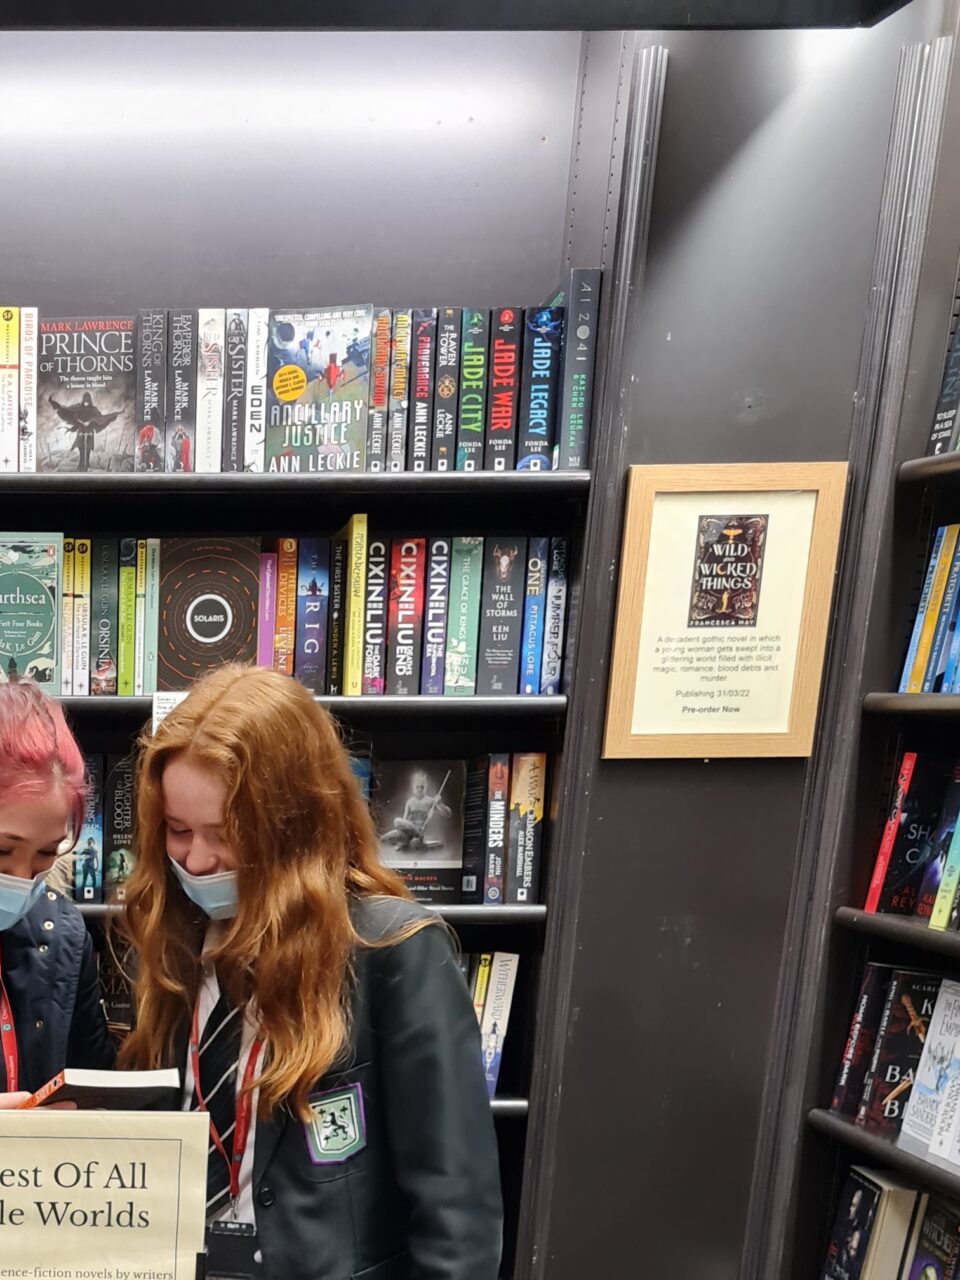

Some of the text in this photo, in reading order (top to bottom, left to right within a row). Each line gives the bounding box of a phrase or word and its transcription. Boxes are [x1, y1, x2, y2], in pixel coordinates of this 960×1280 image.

[41, 320, 133, 331] MARK LAWRENCE
[41, 331, 133, 354] PRINCE
[40, 355, 134, 373] OF THORNS
[460, 342, 485, 433] JADE CITY
[491, 339, 516, 431] JADE WAR
[269, 452, 360, 473] ANN LECKIE
[712, 544, 748, 556] WILD
[700, 563, 756, 576] WICKED
[495, 585, 511, 593] THE
[700, 577, 752, 590] THINGS
[492, 592, 514, 602] WALL
[496, 601, 508, 609] OF
[194, 614, 225, 623] SOLARIS
[486, 608, 517, 617] STORMS
[493, 625, 509, 633] KEN
[493, 633, 508, 641] LIU
[676, 690, 714, 698] Publishing
[54, 1161, 99, 1188] Of
[104, 1163, 147, 1189] All
[34, 1201, 149, 1228] Worlds
[75, 1268, 112, 1279] novels
[116, 1268, 130, 1280] by
[133, 1269, 173, 1280] writers
